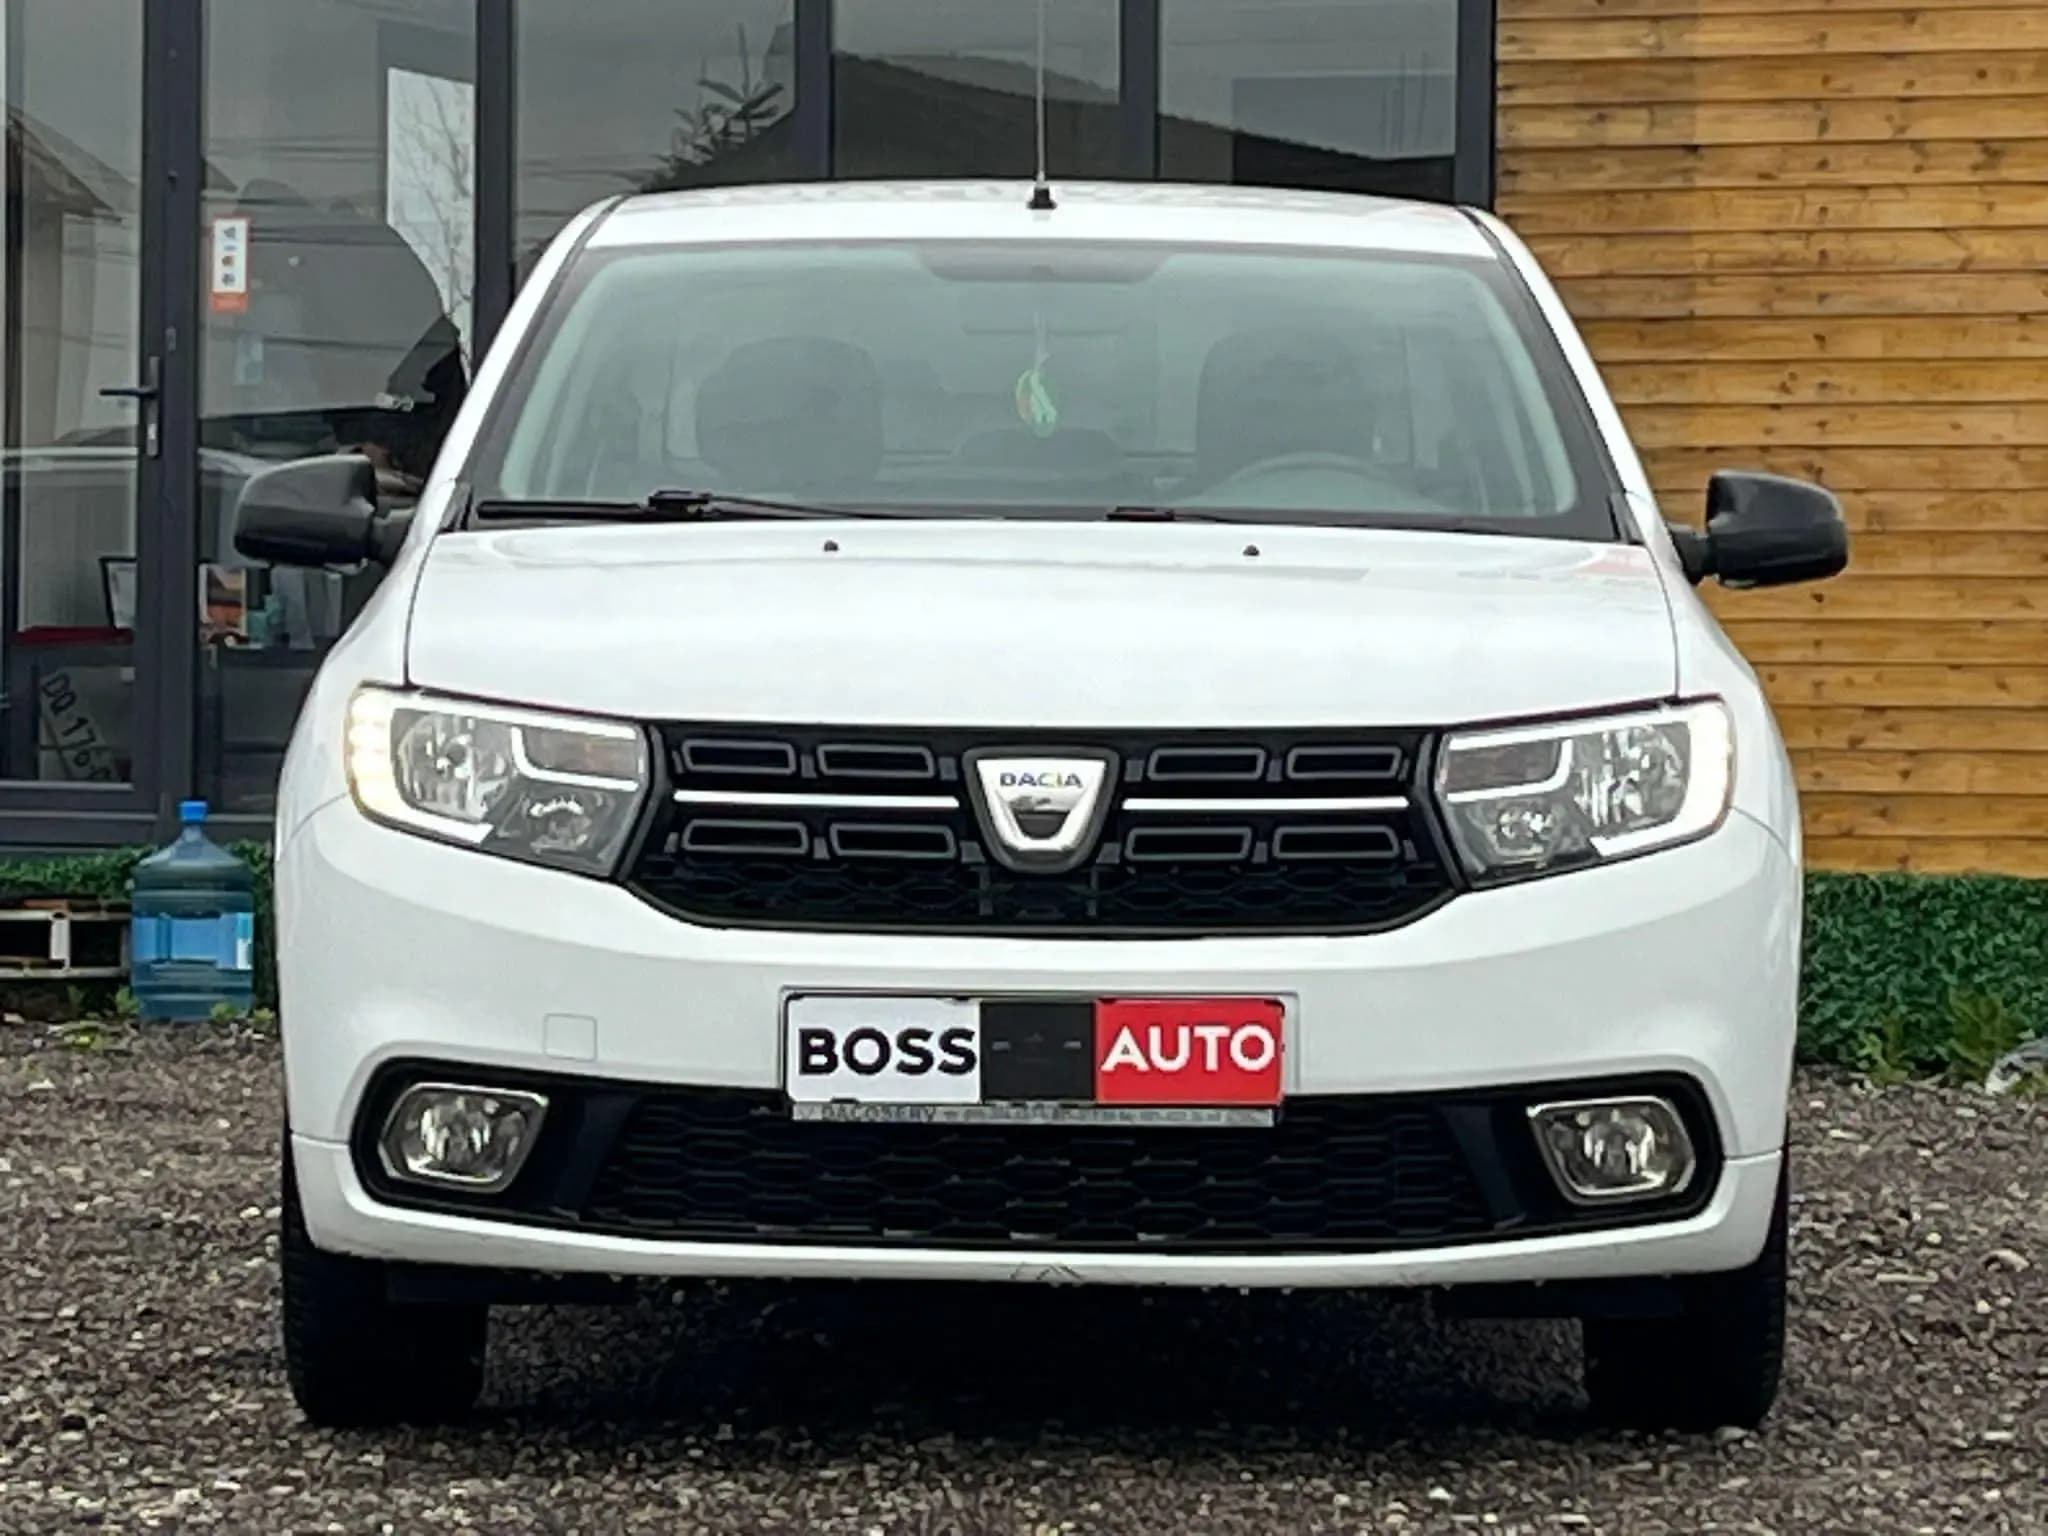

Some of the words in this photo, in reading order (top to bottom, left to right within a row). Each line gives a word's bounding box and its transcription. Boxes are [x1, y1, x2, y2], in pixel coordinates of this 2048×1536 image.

[999, 772, 1083, 788] DACIA
[799, 1027, 977, 1076] BOSS
[1101, 1025, 1275, 1071] AUTO
